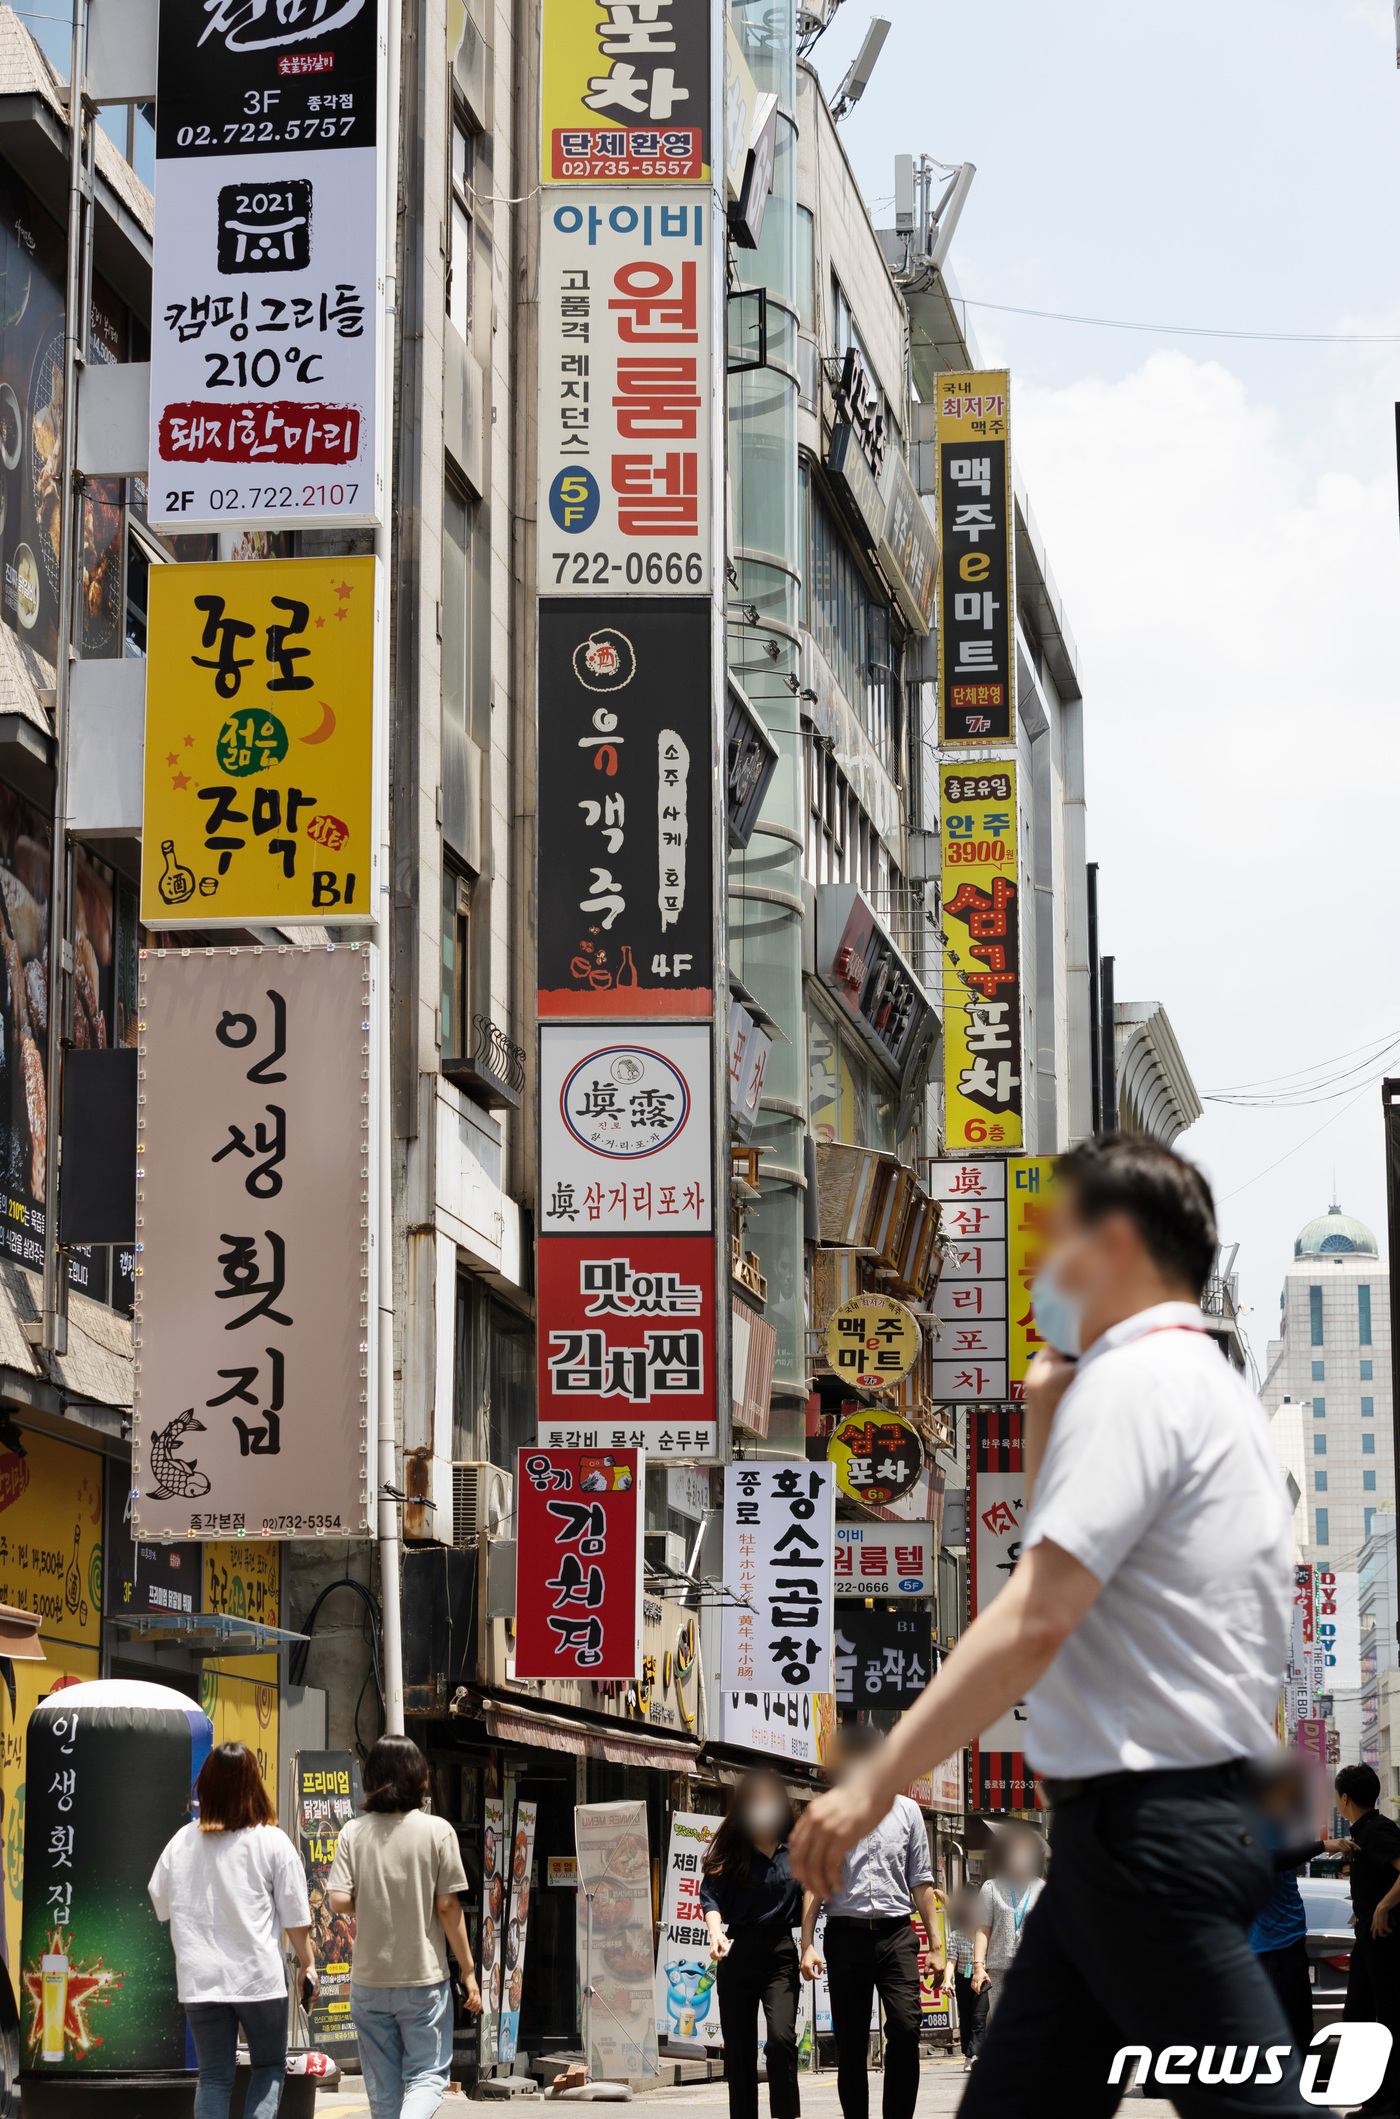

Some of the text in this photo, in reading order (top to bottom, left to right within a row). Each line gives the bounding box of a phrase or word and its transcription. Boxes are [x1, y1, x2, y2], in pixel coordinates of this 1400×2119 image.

[279, 54, 333, 75] 숯불닭갈비
[243, 90, 281, 115] 3F
[306, 93, 353, 112] 종각점
[176, 116, 356, 147] 02.722.5757
[561, 132, 692, 158] 단체환영
[562, 161, 693, 177] 02)735-5557
[235, 193, 293, 215] 2021
[553, 205, 702, 246] 아이비
[559, 269, 591, 455] 고품격 레지던스
[608, 261, 702, 537] 원룸텔
[942, 382, 972, 395] 국내
[941, 394, 1005, 420] 최저가
[170, 409, 353, 456] 돼지한마리
[971, 419, 1005, 435] 맥주
[165, 490, 195, 512] 2F
[209, 483, 359, 512] 02.722.2107
[846, 442, 882, 540] POCHA
[552, 551, 703, 585] 722-0666
[950, 457, 1000, 673] 맥주e마트
[191, 595, 315, 699] 종로
[952, 683, 1002, 706] 단체환영
[965, 714, 991, 733] 7F
[220, 717, 279, 771] 젊은
[948, 776, 1006, 800] 종로유일
[197, 786, 318, 879] 주막
[663, 744, 682, 912] 소주 사케 호프
[166, 872, 188, 895] 酒
[651, 953, 694, 978] 4F
[575, 1080, 675, 1129] 眞露
[597, 1121, 622, 1130] 진로
[963, 1118, 1006, 1143] 6층
[205, 988, 294, 1457] 인생횟집
[580, 1257, 702, 1317] 맛있는
[844, 1302, 860, 1315] 국내
[861, 1298, 887, 1309] 최저가
[838, 1318, 904, 1343] 맥주
[548, 1328, 704, 1403] 김치찜
[838, 1348, 904, 1374] 마트
[548, 1430, 598, 1448] 통갈비
[658, 1430, 711, 1451] 순두부
[837, 1421, 907, 1454] 삼구
[525, 1455, 573, 1491] 옹기
[847, 1457, 911, 1486] 포차
[736, 1470, 762, 1525] 종로
[190, 1513, 246, 1530] 종각본점
[262, 1513, 342, 1531] 02)732-5354
[834, 1529, 863, 1543] 이비
[768, 1469, 827, 1686] 황소곱창
[903, 1580, 920, 1591] 5F
[123, 1581, 132, 1603] 3F
[1320, 1572, 1337, 1615] DVD
[897, 1621, 917, 1633] B1
[1320, 1624, 1337, 1667] DVD
[864, 1647, 926, 1694] 공작소
[1314, 1646, 1323, 1686] THE BOX
[302, 1770, 350, 1796] 프리미엄
[984, 1779, 1006, 1790] 종로점
[46, 1713, 79, 1926] 인생횟집
[303, 1799, 332, 1820] 닭갈비
[552, 1862, 578, 1873] 영업
[672, 1852, 698, 1873] 저희
